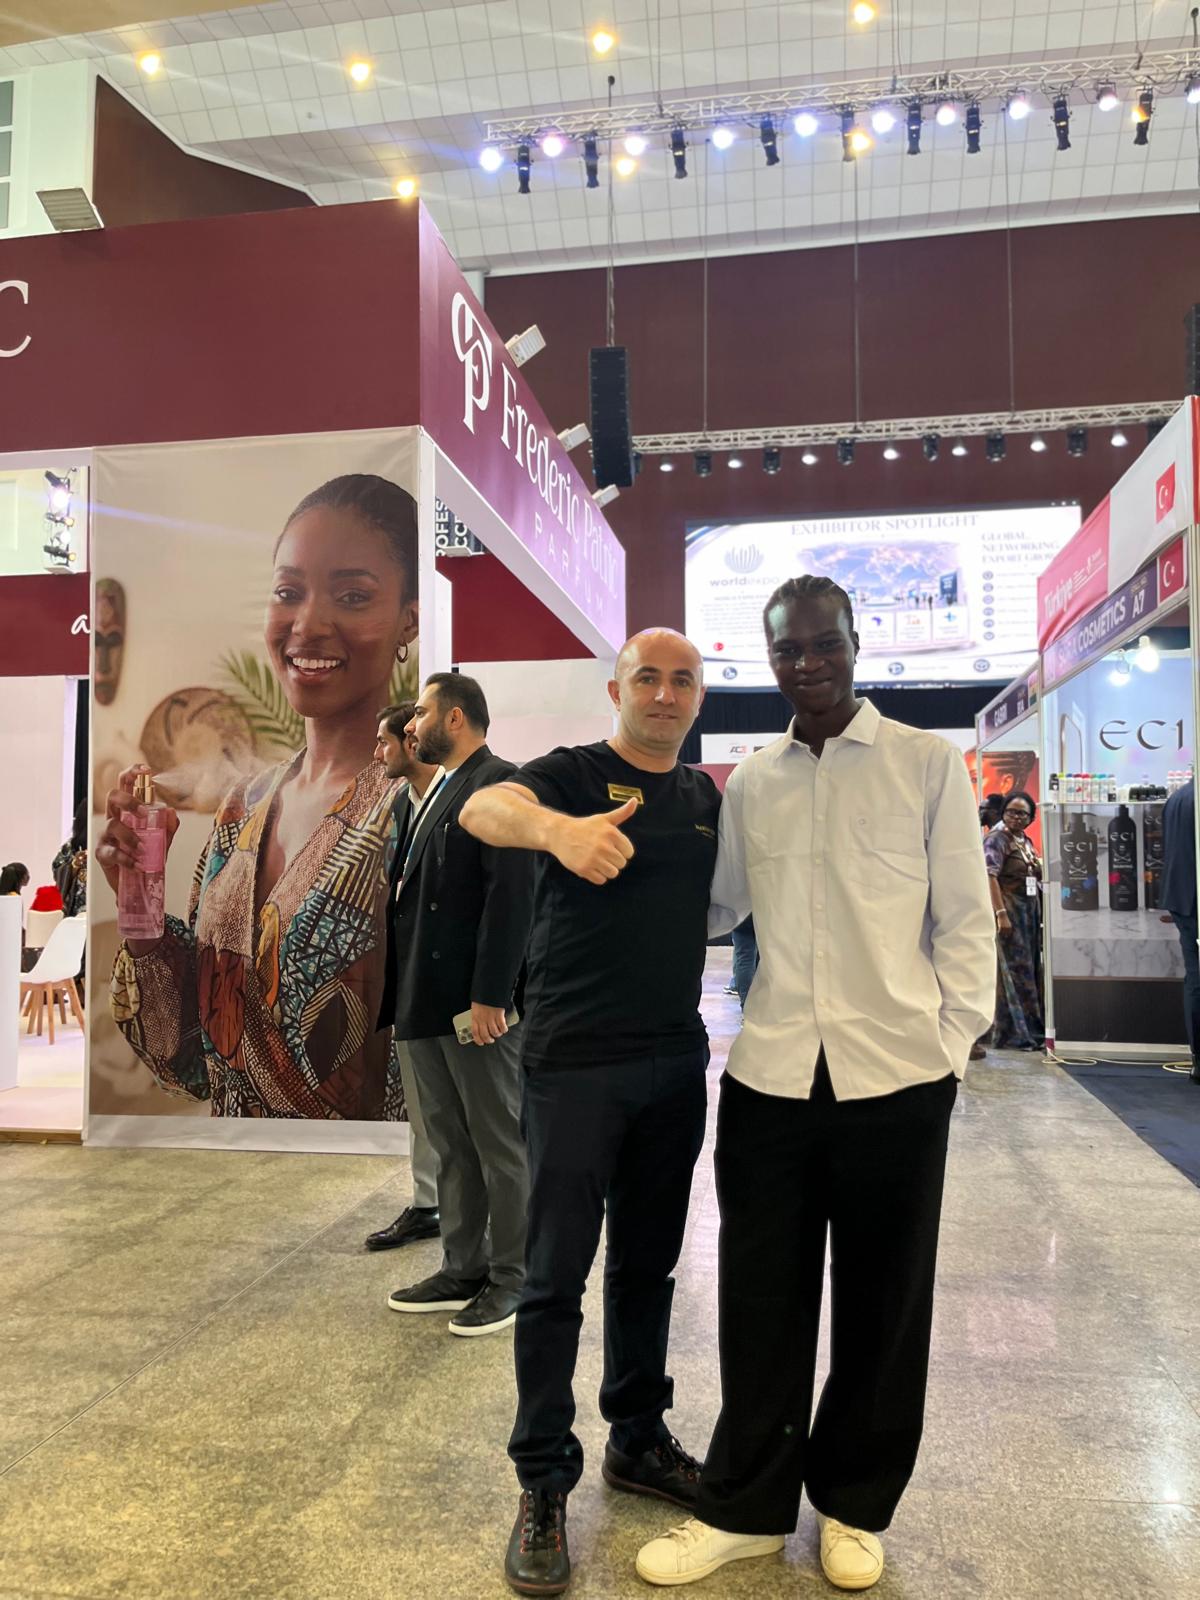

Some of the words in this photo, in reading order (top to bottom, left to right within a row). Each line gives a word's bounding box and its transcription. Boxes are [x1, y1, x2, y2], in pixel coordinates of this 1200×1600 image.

[500, 362, 582, 544] Frederic
[791, 518, 881, 536] EXHIBITOR
[885, 514, 979, 531] SPOTLIGHT
[1077, 595, 1126, 652] COSMETICS
[1132, 589, 1145, 618] A7
